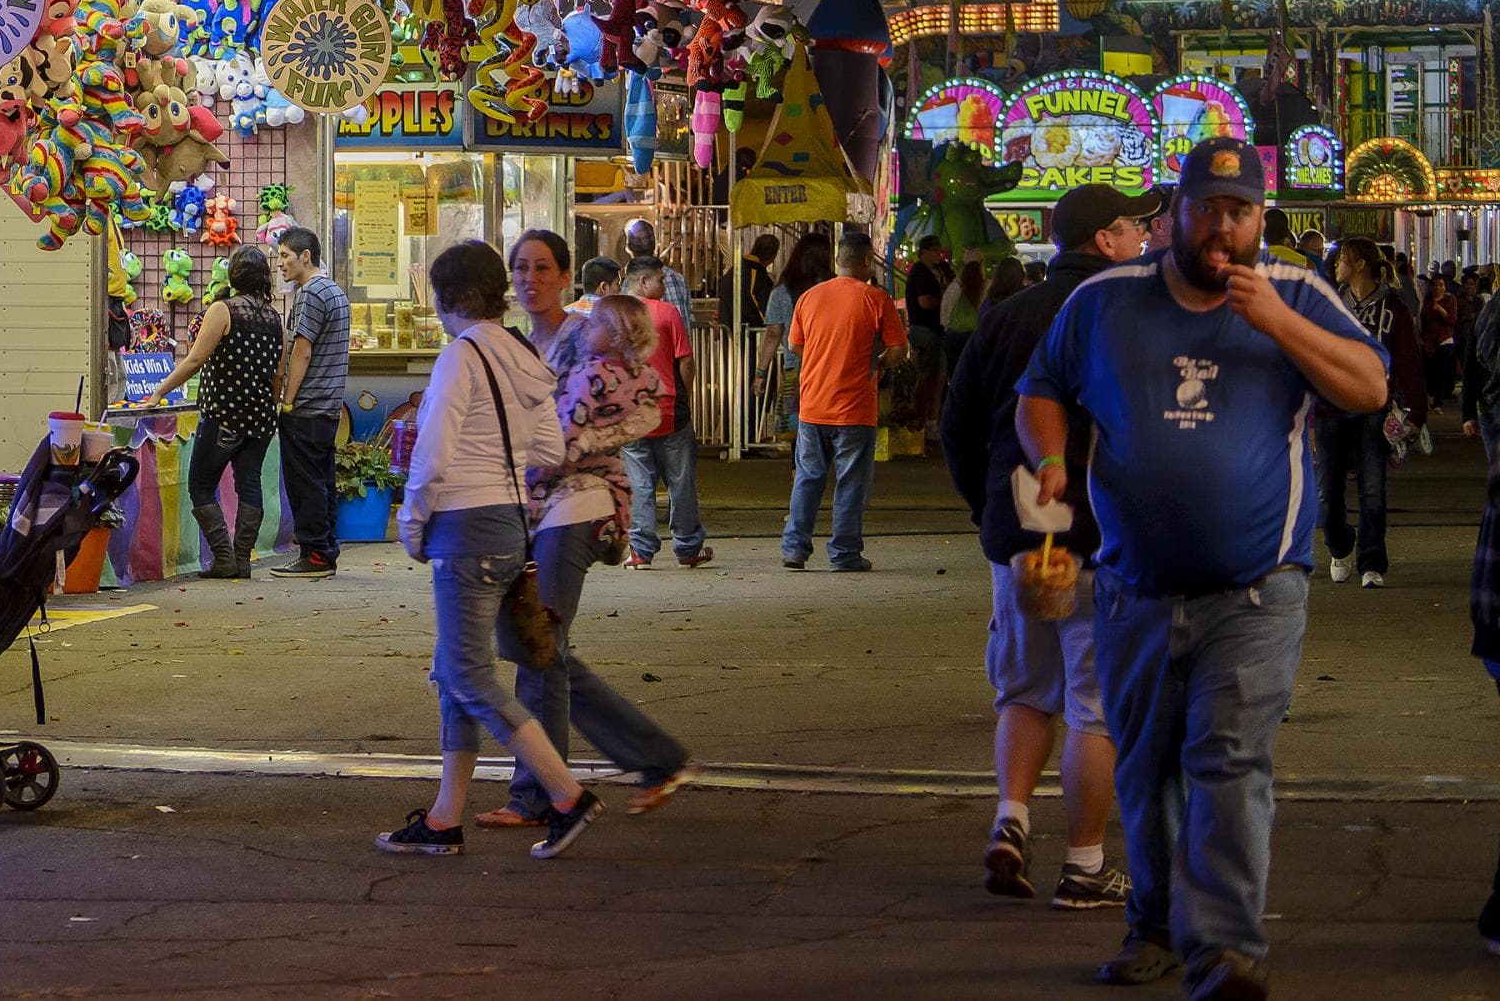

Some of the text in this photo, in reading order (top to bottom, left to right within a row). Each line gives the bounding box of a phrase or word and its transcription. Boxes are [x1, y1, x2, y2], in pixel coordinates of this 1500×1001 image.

[349, 3, 387, 64] GUN
[284, 67, 353, 108] FUN
[1025, 88, 1132, 122] FUNNEL
[485, 112, 613, 140] DRINKS
[1018, 166, 1145, 189] CAKES
[763, 184, 808, 205] ENTER
[123, 358, 171, 375] Kids Win A
[125, 379, 143, 395] Prize
